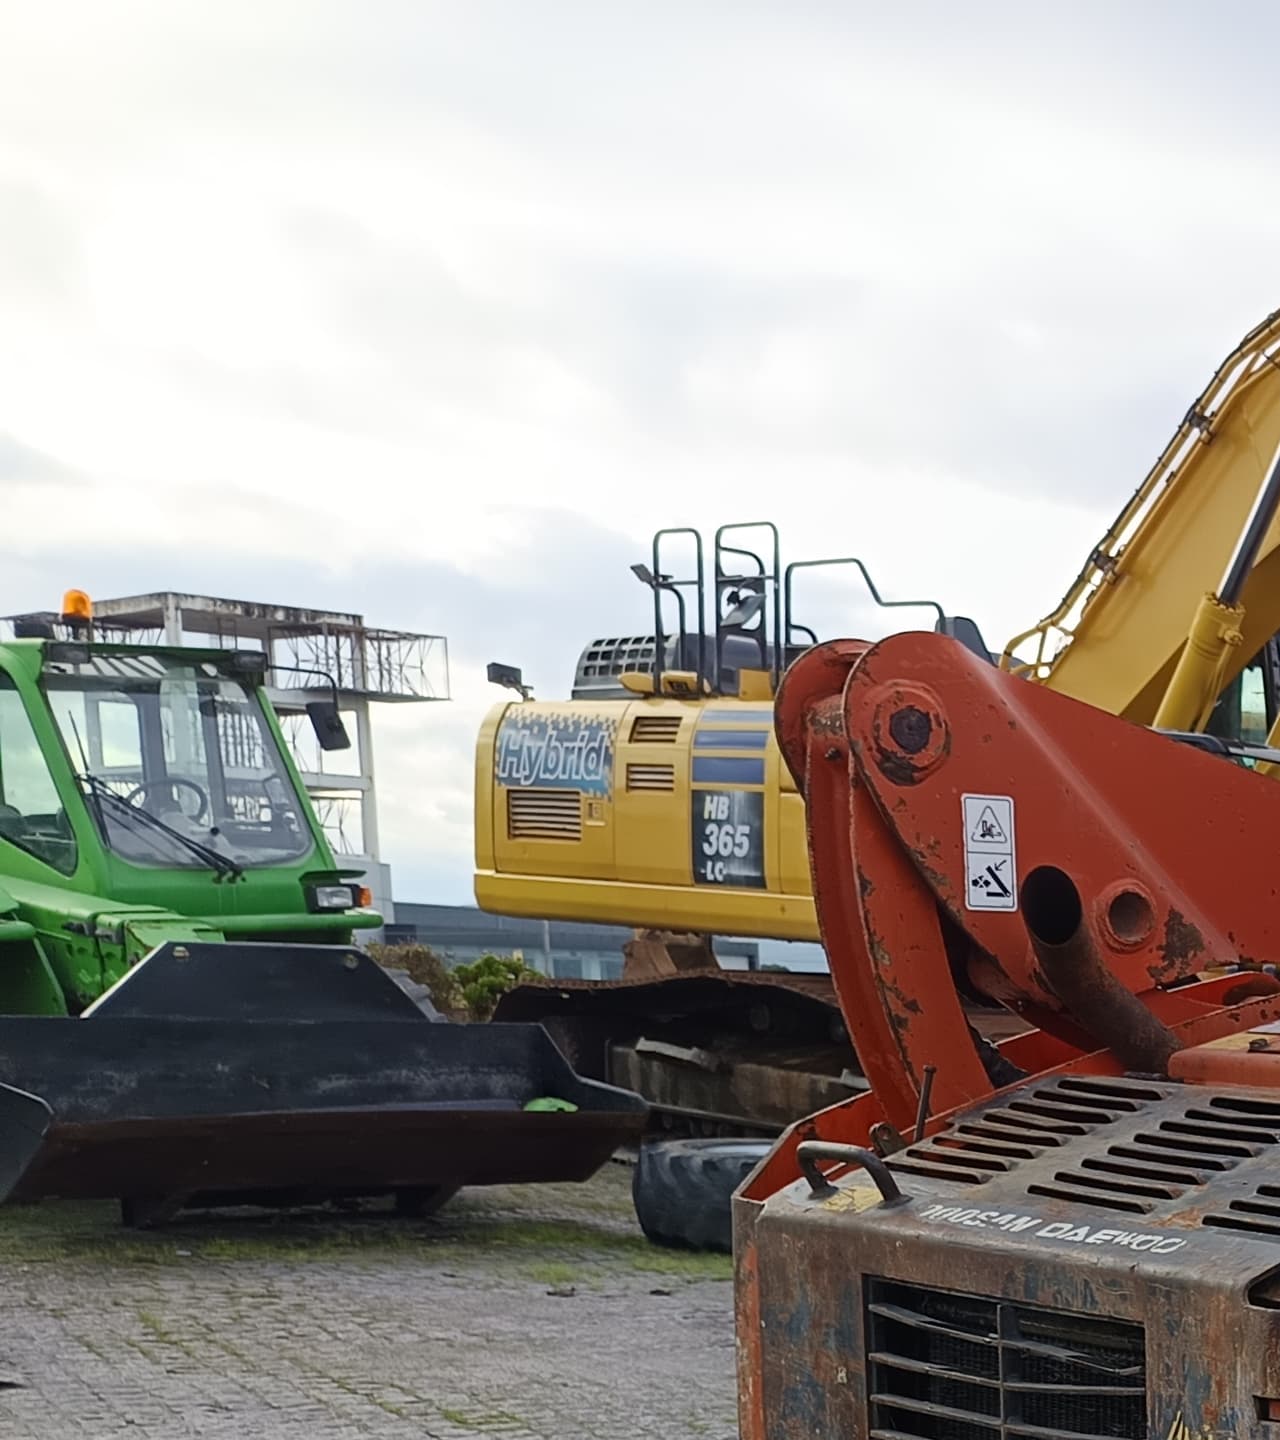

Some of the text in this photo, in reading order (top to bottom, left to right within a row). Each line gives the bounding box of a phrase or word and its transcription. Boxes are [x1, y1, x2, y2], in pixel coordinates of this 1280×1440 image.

[498, 729, 609, 786] Hybrid
[703, 795, 730, 820] HB
[702, 824, 751, 857] 365
[1035, 1222, 1188, 1255] DAEWOO
